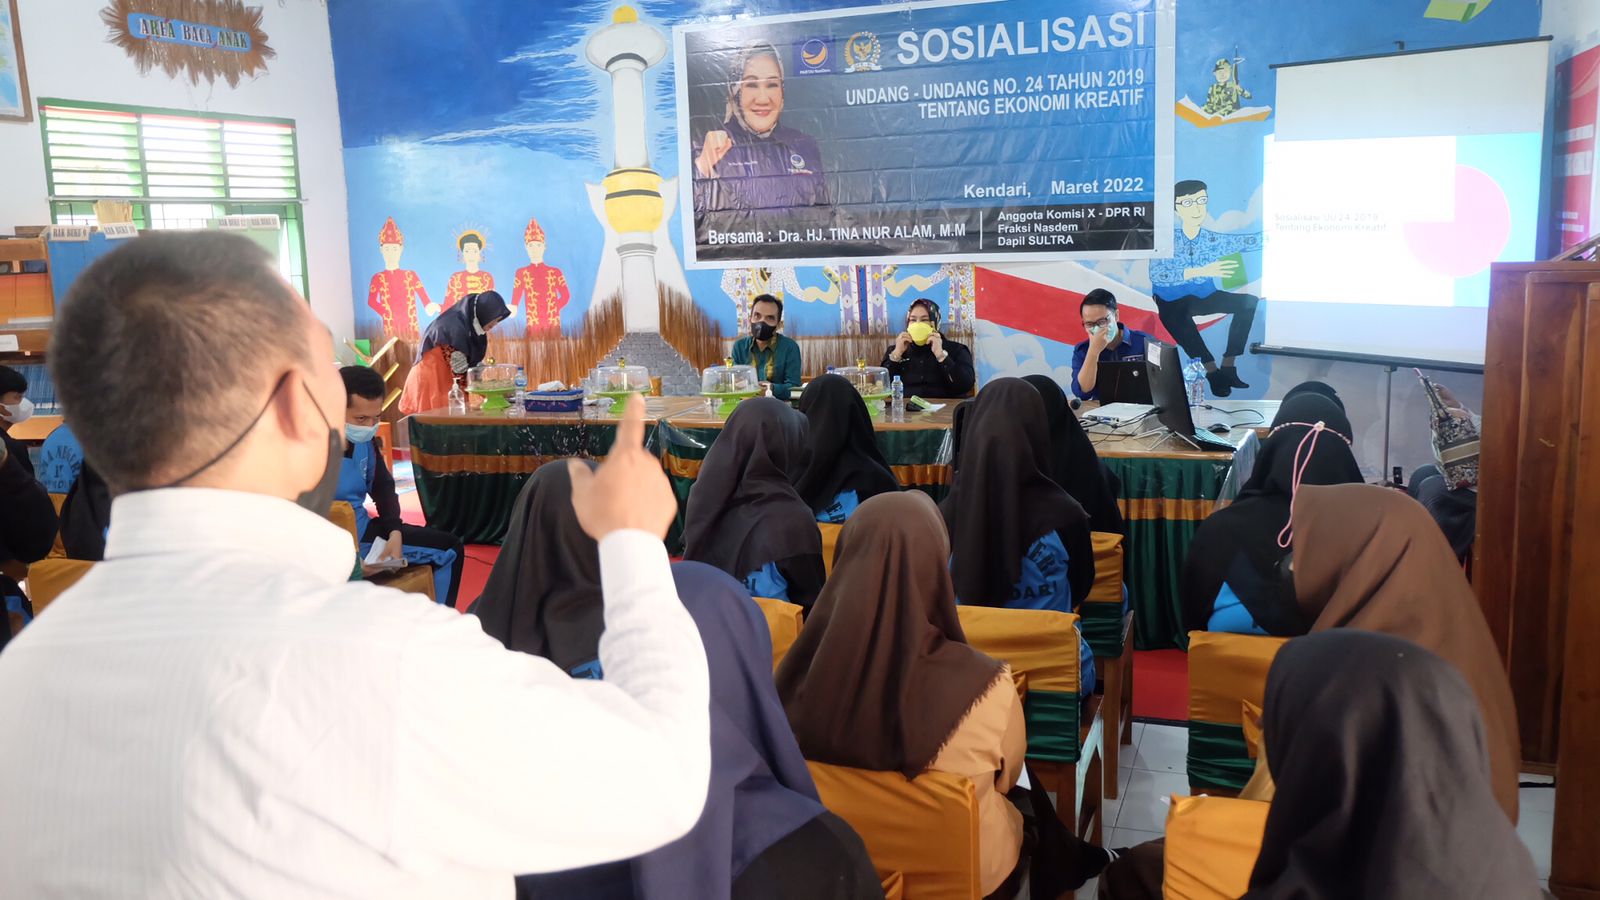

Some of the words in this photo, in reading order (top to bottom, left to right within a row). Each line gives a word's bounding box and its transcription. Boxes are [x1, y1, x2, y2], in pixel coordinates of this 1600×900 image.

[140, 18, 175, 38] AREA
[181, 24, 212, 43] BACA
[217, 31, 248, 49] ANAK
[897, 11, 1145, 65] SOSIALISASI
[846, 86, 909, 105] UNDANG
[923, 79, 989, 100] UNDANG
[993, 78, 1021, 95] NO.
[1025, 76, 1043, 93] 24
[1047, 71, 1103, 91] TAHUN
[1107, 68, 1144, 87] 2019
[918, 98, 990, 119] TENTANG
[995, 94, 1070, 115] EKONOMI
[1075, 88, 1144, 109] KREATIF
[964, 182, 1032, 198] Kendari,
[1051, 179, 1099, 195] Maret
[1103, 177, 1144, 193] 2022
[997, 211, 1043, 223] Anggota
[1046, 209, 1085, 220] Komisi
[1087, 209, 1096, 218] X
[1105, 207, 1130, 218] DPR
[1133, 206, 1145, 217] RI
[708, 230, 764, 245] Bersama
[779, 230, 803, 242] Dra.
[806, 228, 827, 241] HJ.
[829, 227, 860, 240] TINA
[862, 226, 890, 239] NUR
[894, 225, 936, 240] ALAM,
[939, 223, 966, 237] M.M
[998, 223, 1031, 234] Fraksi
[1034, 222, 1078, 233] Nasdem
[1275, 222, 1310, 233] Tentang
[1312, 223, 1352, 232] Ekonomi
[998, 236, 1025, 248] Dapil
[1028, 235, 1074, 246] SULTRA
